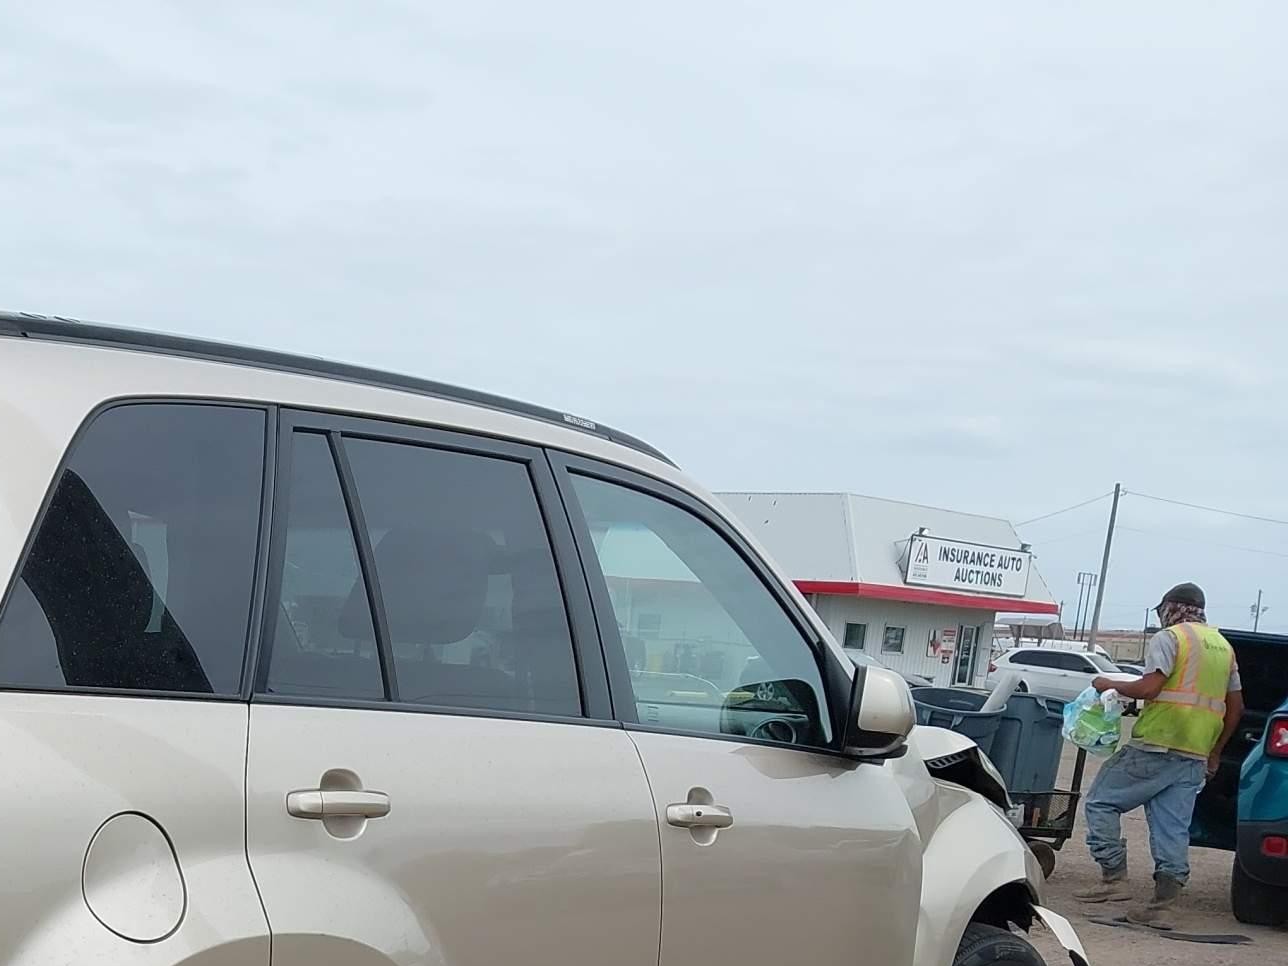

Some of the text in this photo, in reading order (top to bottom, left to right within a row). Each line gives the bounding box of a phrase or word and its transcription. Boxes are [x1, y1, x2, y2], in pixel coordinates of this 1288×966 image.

[938, 545, 1023, 572] INSURANCE AUTO
[953, 567, 1004, 588] AUCTIONS
